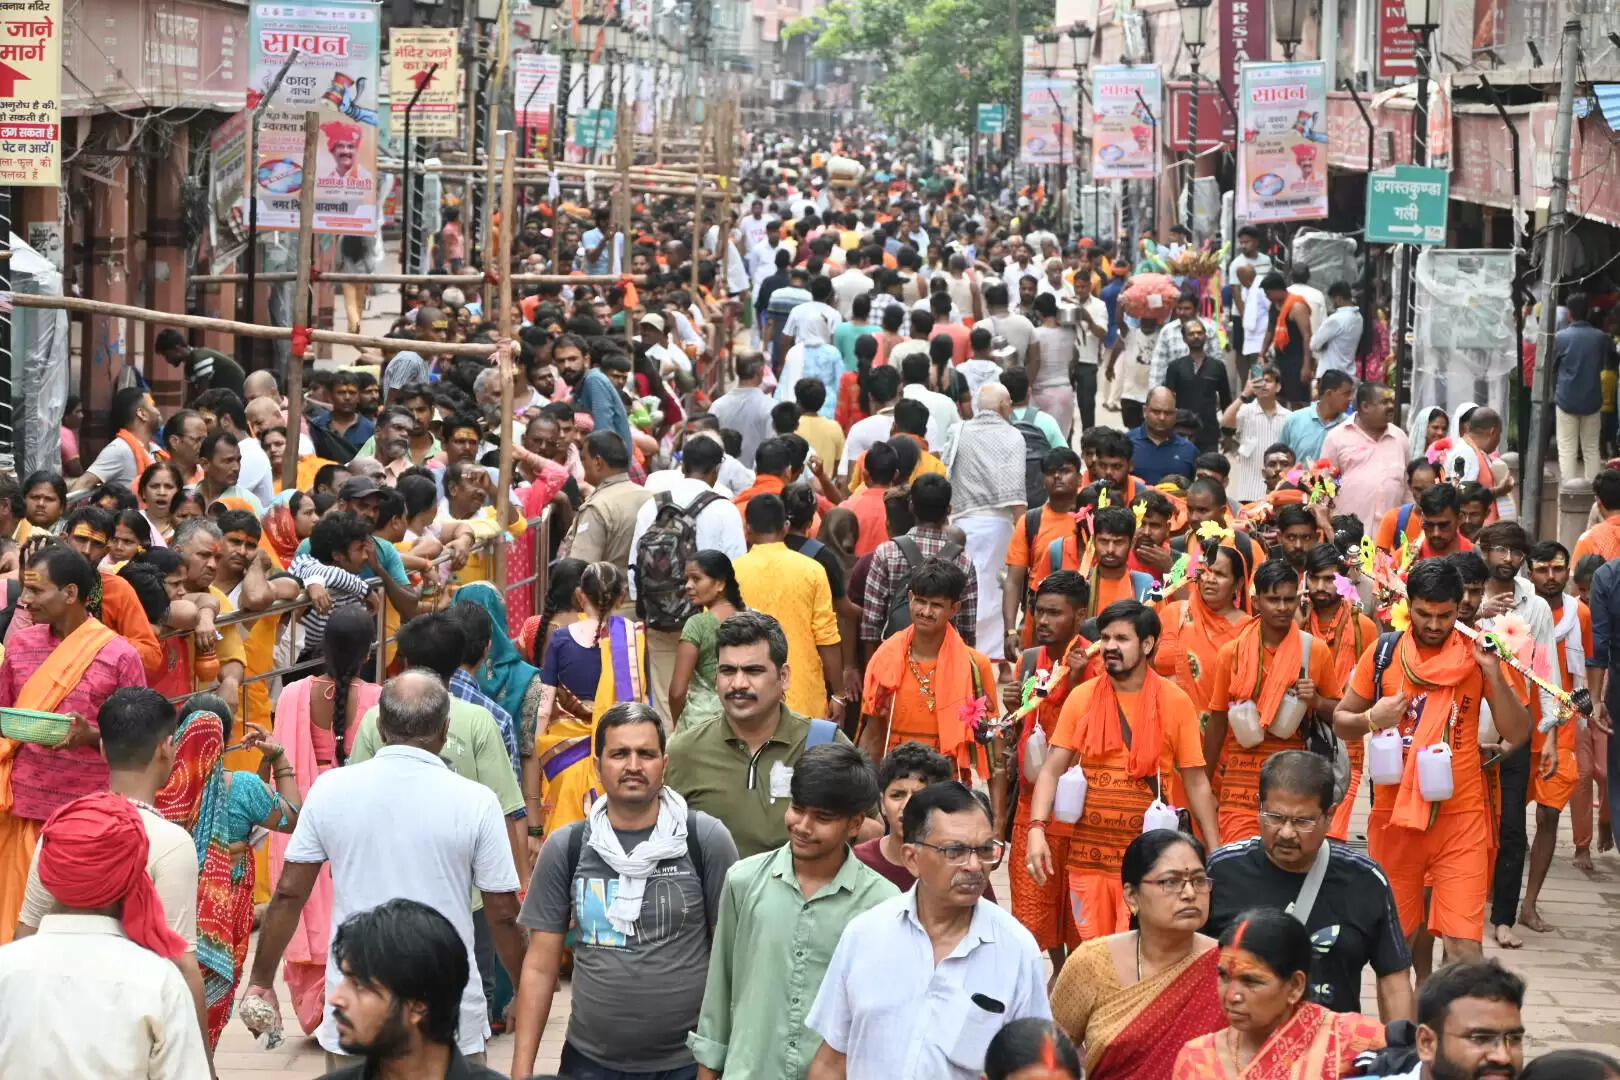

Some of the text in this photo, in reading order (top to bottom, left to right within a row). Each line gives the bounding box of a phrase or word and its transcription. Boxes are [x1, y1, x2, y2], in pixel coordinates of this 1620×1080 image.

[5, 15, 54, 37] जाने
[0, 38, 46, 61] मार्ग
[263, 33, 348, 56] सावन
[1253, 87, 1305, 102] सावन
[1393, 203, 1418, 220] गली
